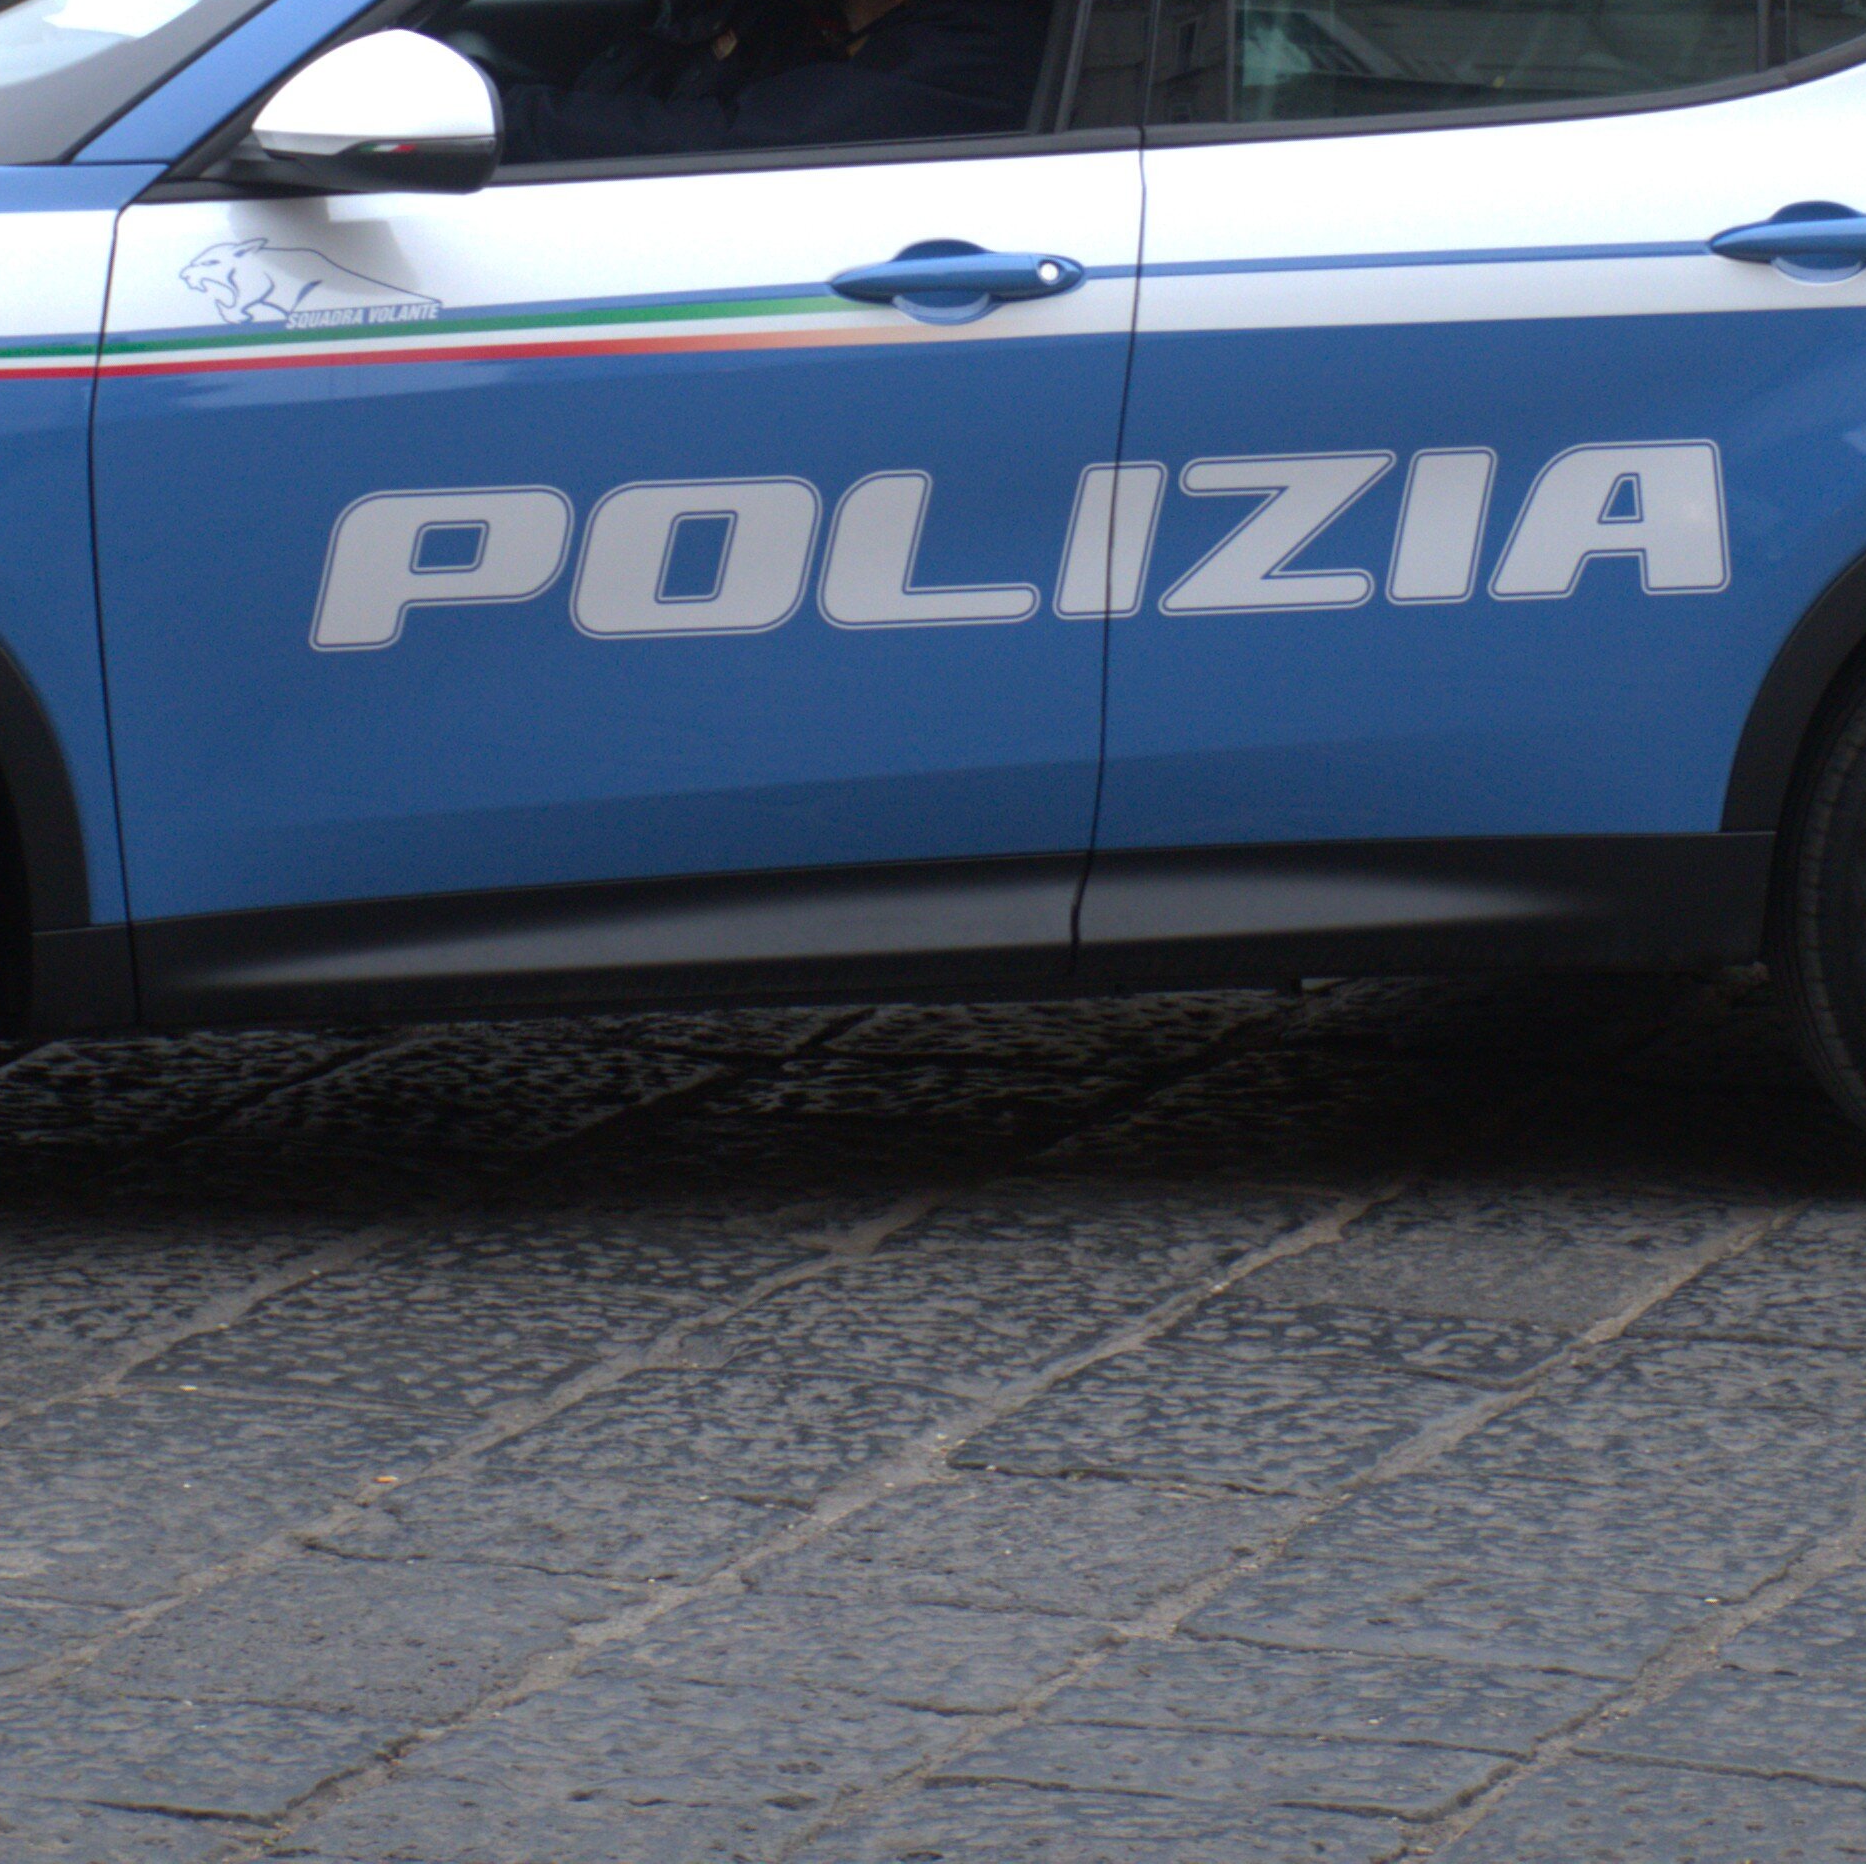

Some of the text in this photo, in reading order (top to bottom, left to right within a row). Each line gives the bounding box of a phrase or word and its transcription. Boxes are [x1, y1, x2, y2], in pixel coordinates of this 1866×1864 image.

[286, 304, 438, 330] SQUADRA VOLANTE
[308, 438, 1731, 652] POLIZIA
